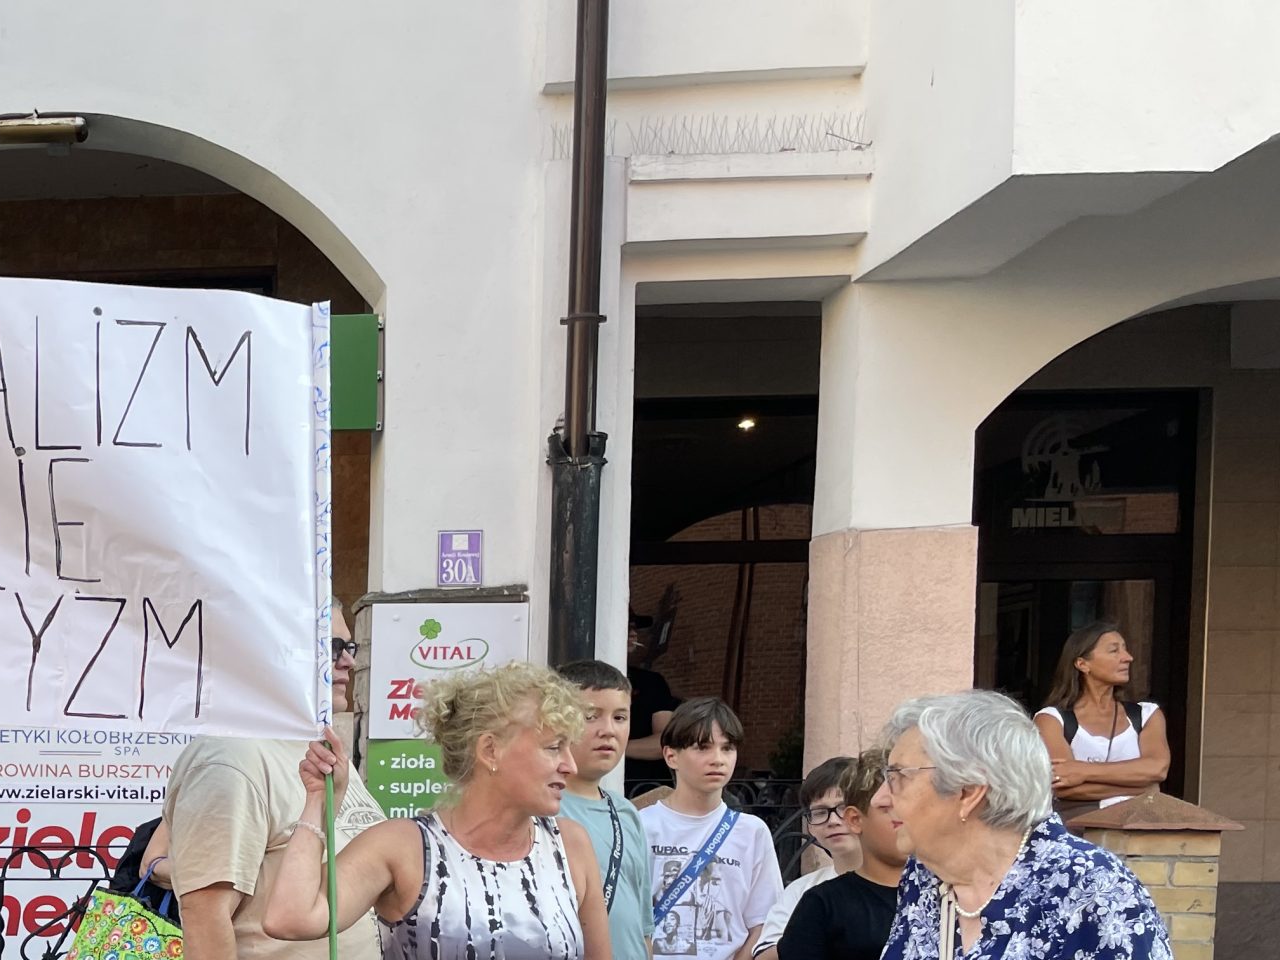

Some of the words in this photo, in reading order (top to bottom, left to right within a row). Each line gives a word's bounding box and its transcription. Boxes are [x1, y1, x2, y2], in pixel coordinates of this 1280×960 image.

[442, 559, 478, 583] 30A
[418, 646, 477, 660] VITAL
[114, 746, 141, 756] SPA
[391, 754, 435, 769] zioła
[704, 821, 731, 855] Reebok
[651, 844, 689, 854] TUPAC
[659, 875, 693, 913] Reebok
